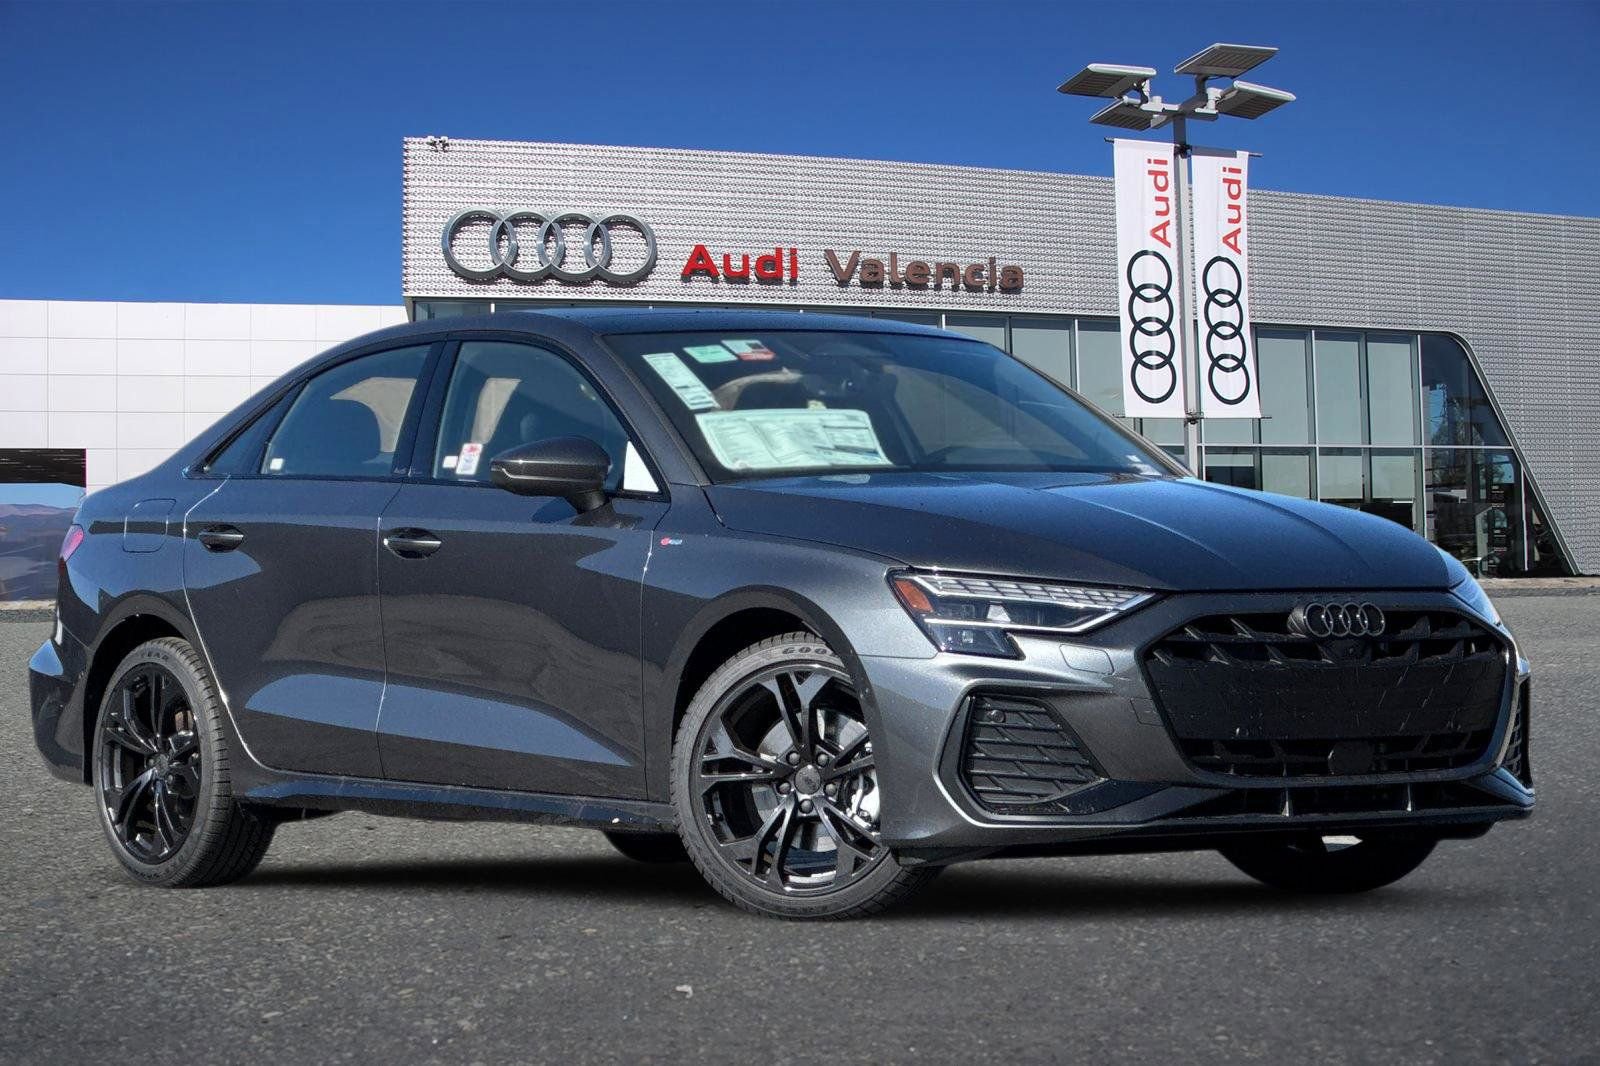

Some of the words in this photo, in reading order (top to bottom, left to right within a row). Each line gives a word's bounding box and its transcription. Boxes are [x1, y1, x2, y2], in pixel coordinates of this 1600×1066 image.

[1147, 158, 1171, 248] Audi
[1222, 166, 1242, 255] Audi
[682, 244, 798, 282] Audi
[824, 249, 1024, 291] Valencia
